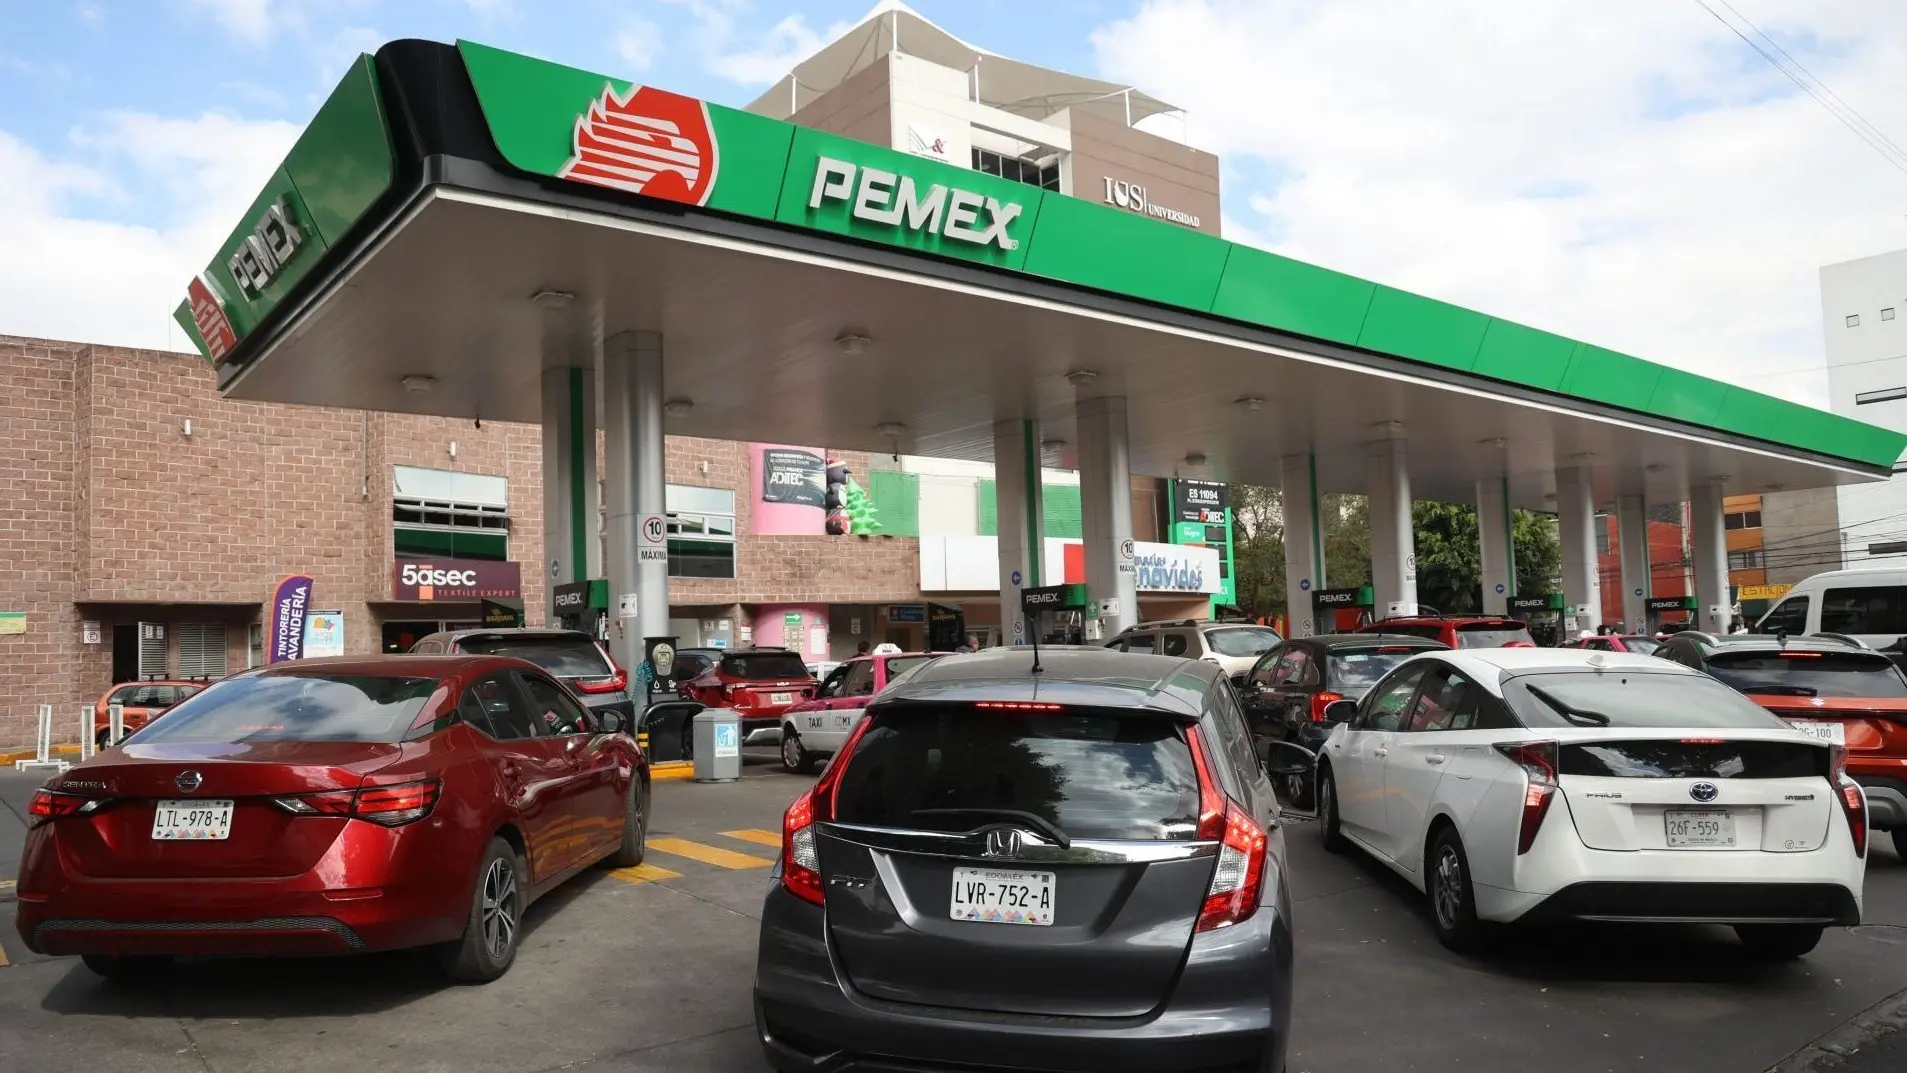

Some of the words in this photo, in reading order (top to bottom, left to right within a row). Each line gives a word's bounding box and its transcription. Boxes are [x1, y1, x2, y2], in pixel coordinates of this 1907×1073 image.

[809, 155, 1023, 250] PEMEX
[1148, 203, 1200, 228] UNIVERSIDAD
[228, 195, 302, 302] PEMEX
[1189, 488, 1198, 499] ES
[1199, 489, 1218, 500] 11094
[648, 521, 661, 535] 10
[438, 589, 477, 597] TEXTILE
[480, 589, 516, 597] EXPERT
[555, 592, 582, 607] PEMEX
[1026, 592, 1060, 604] PEMEX
[1319, 593, 1351, 602] PEMEX
[1651, 601, 1680, 609] PEMEX
[277, 598, 292, 657] TINTORERÍA
[287, 586, 308, 661] AVANDERÍA
[808, 717, 823, 729] TAXI
[156, 810, 229, 827] LTL-978-A
[1669, 820, 1719, 836] 26F-559
[954, 881, 1050, 909] LVR-752-A
